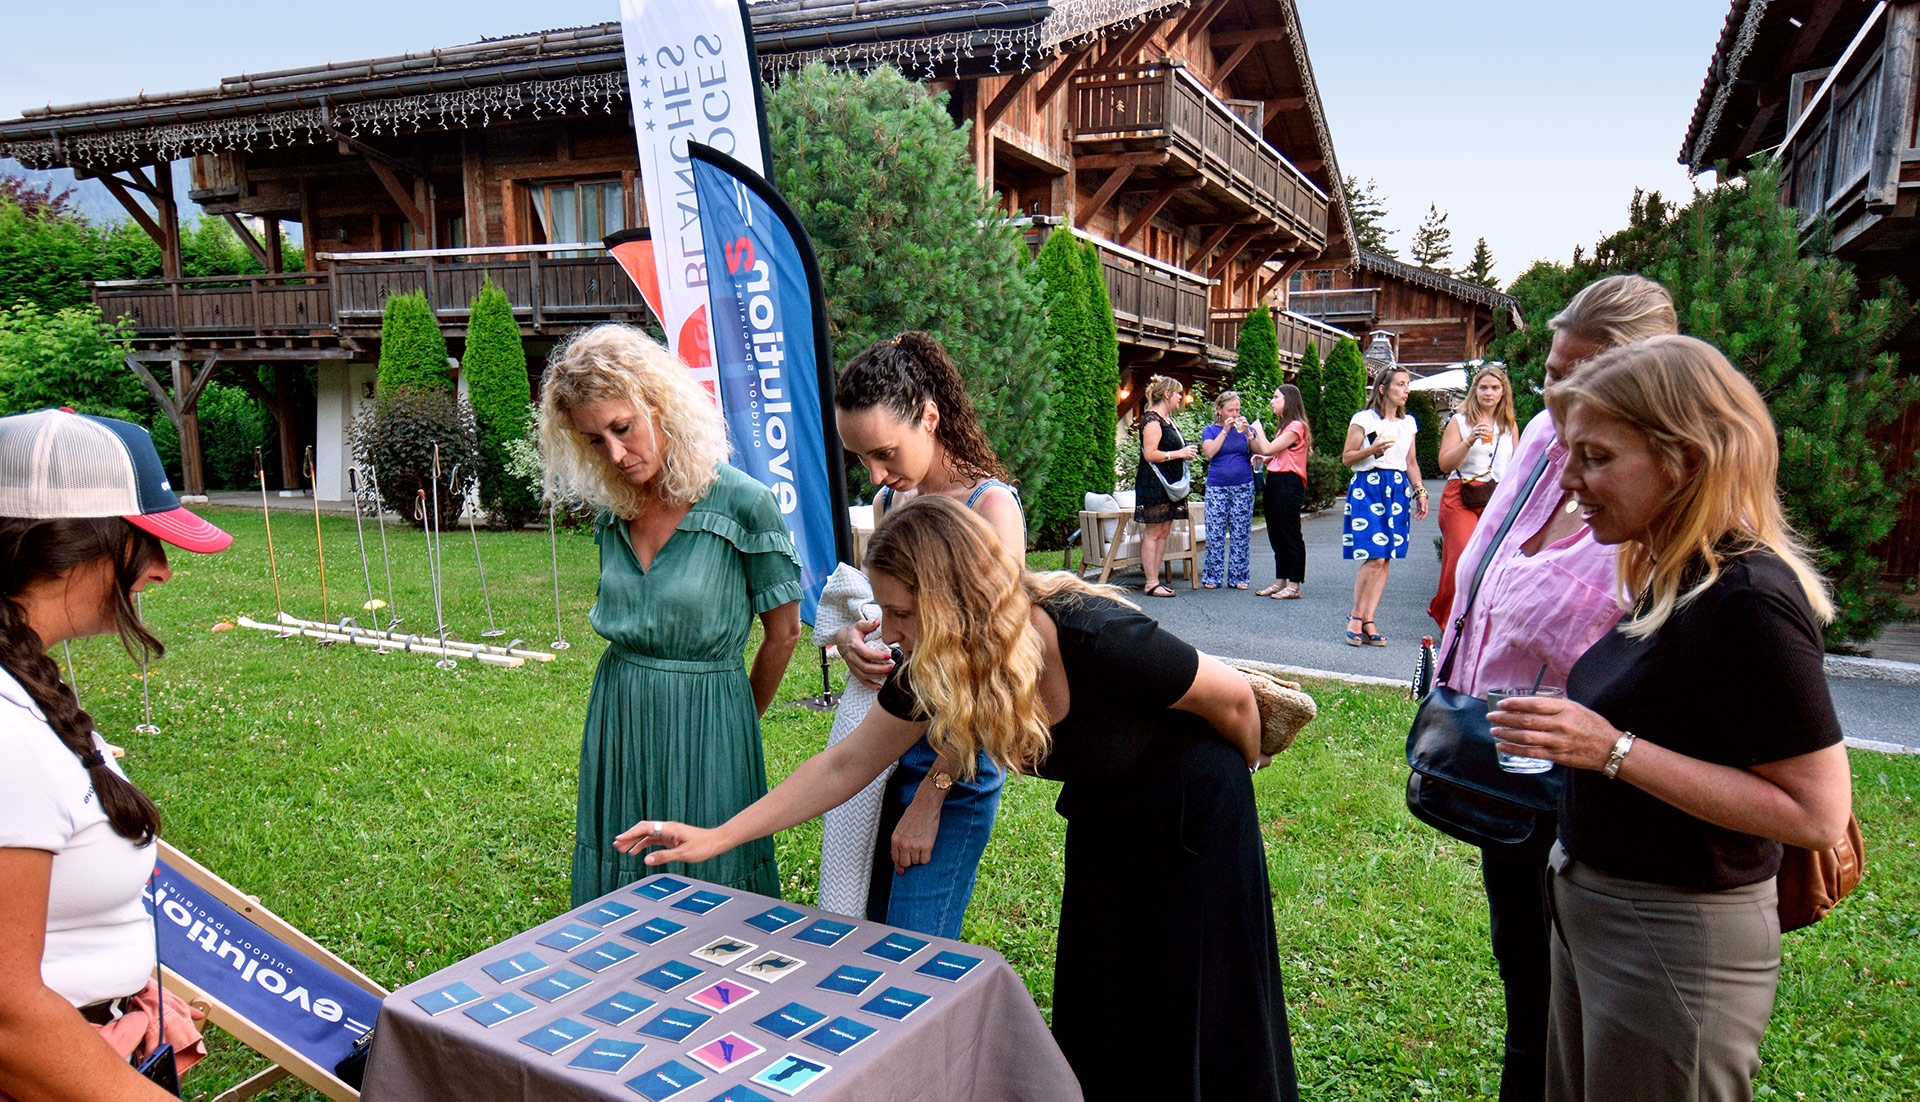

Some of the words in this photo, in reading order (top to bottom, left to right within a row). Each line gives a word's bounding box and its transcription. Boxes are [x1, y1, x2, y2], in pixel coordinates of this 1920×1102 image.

[162, 880, 232, 936] specialist
[142, 868, 344, 1023] evolution
[238, 937, 294, 975] outdoor
